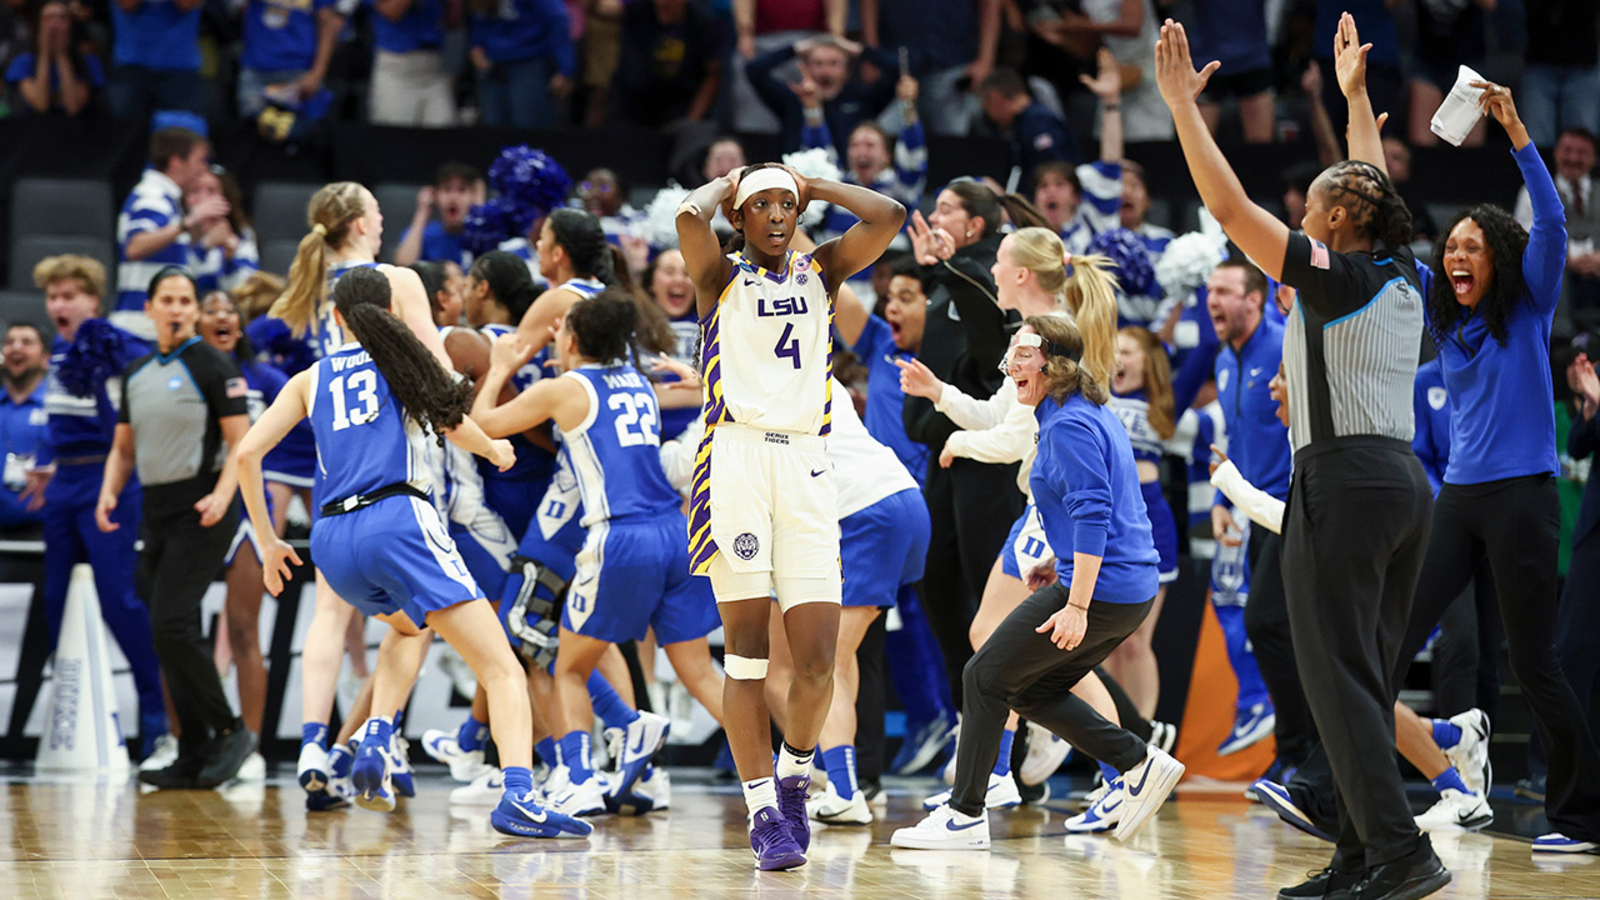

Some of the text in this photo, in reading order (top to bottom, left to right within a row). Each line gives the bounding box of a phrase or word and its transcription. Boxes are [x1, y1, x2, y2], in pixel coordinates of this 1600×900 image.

[757, 296, 809, 317] LSU
[774, 321, 802, 370] 4
[328, 368, 380, 432] 13
[607, 391, 661, 448] 22
[764, 437, 790, 445] TIGERS
[765, 431, 789, 440] GEAUX
[1021, 535, 1046, 559] D
